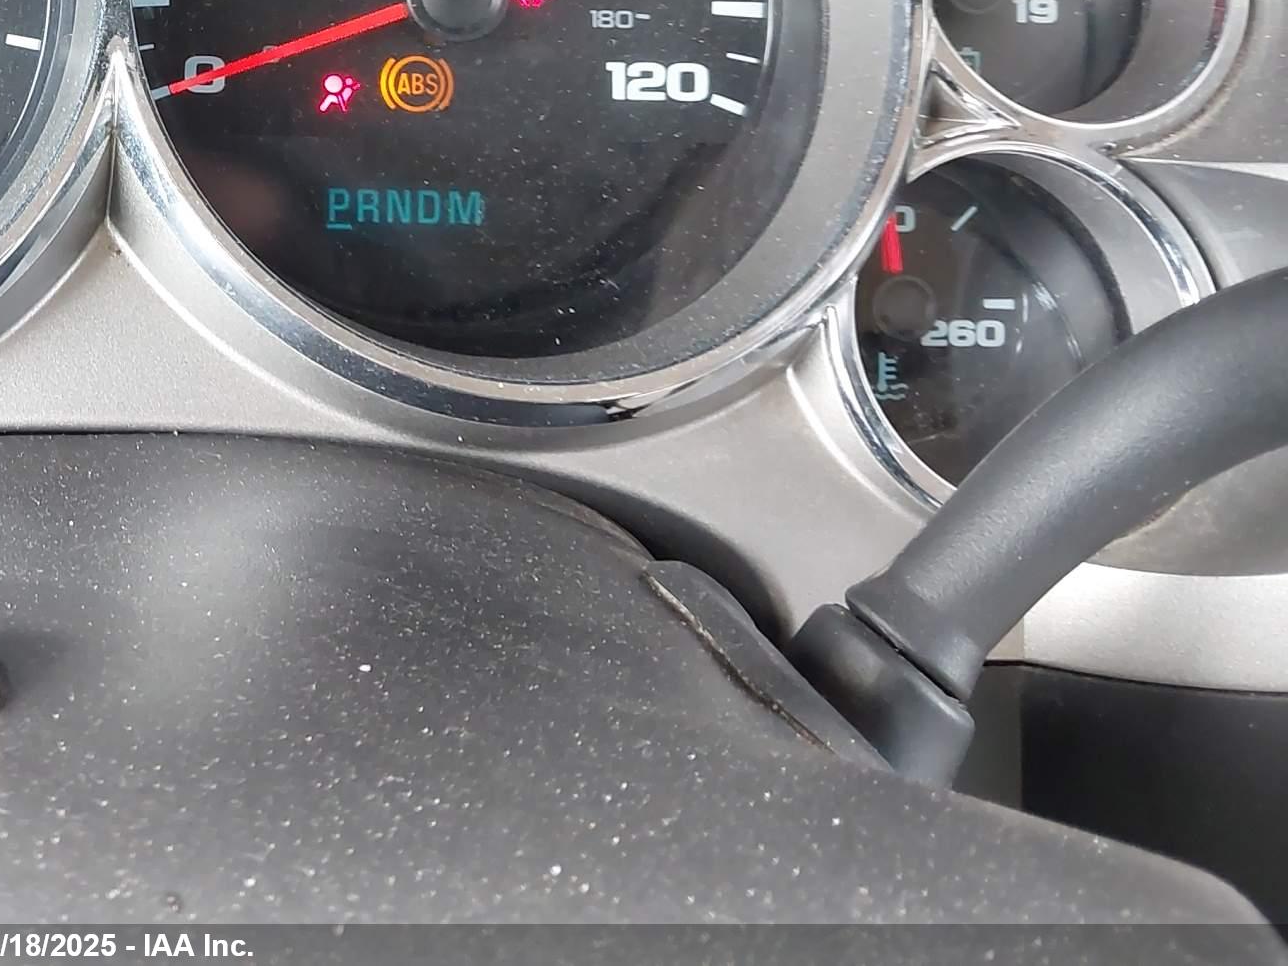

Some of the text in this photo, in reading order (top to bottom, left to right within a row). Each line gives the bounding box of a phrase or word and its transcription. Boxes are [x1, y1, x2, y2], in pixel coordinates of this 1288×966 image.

[590, 10, 633, 29] 180
[184, 55, 225, 93] 0
[397, 72, 438, 95] ABS
[606, 62, 710, 101] 120
[920, 319, 1006, 348] 260
